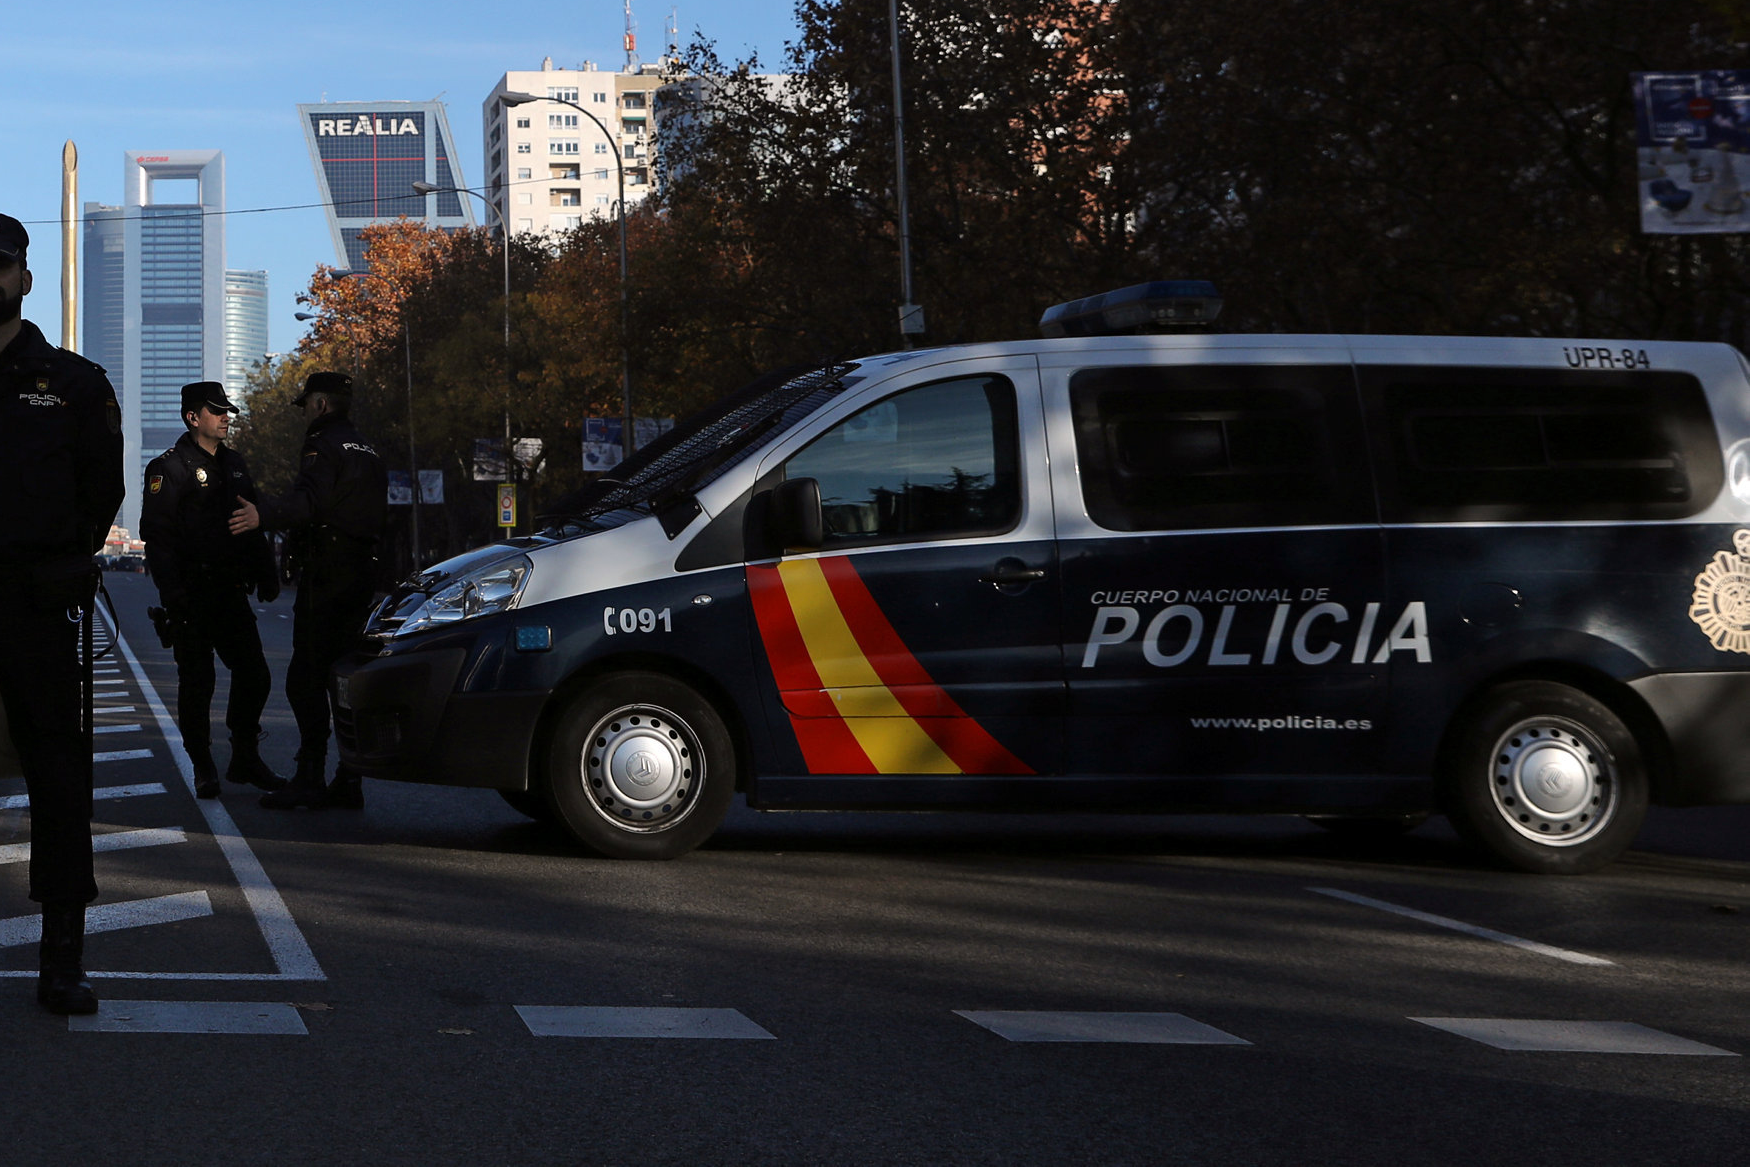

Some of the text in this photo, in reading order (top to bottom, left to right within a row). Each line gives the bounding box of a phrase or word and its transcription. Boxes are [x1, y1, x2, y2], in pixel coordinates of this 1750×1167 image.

[319, 115, 419, 136] REALIA
[1563, 347, 1650, 369] UPR-84
[30, 399, 54, 407] CNP
[1091, 588, 1330, 604] CUERPO NACIONAL DE
[620, 608, 672, 633] 091
[1082, 601, 1432, 669] POLICIA
[1190, 716, 1372, 732] www.policia.es
